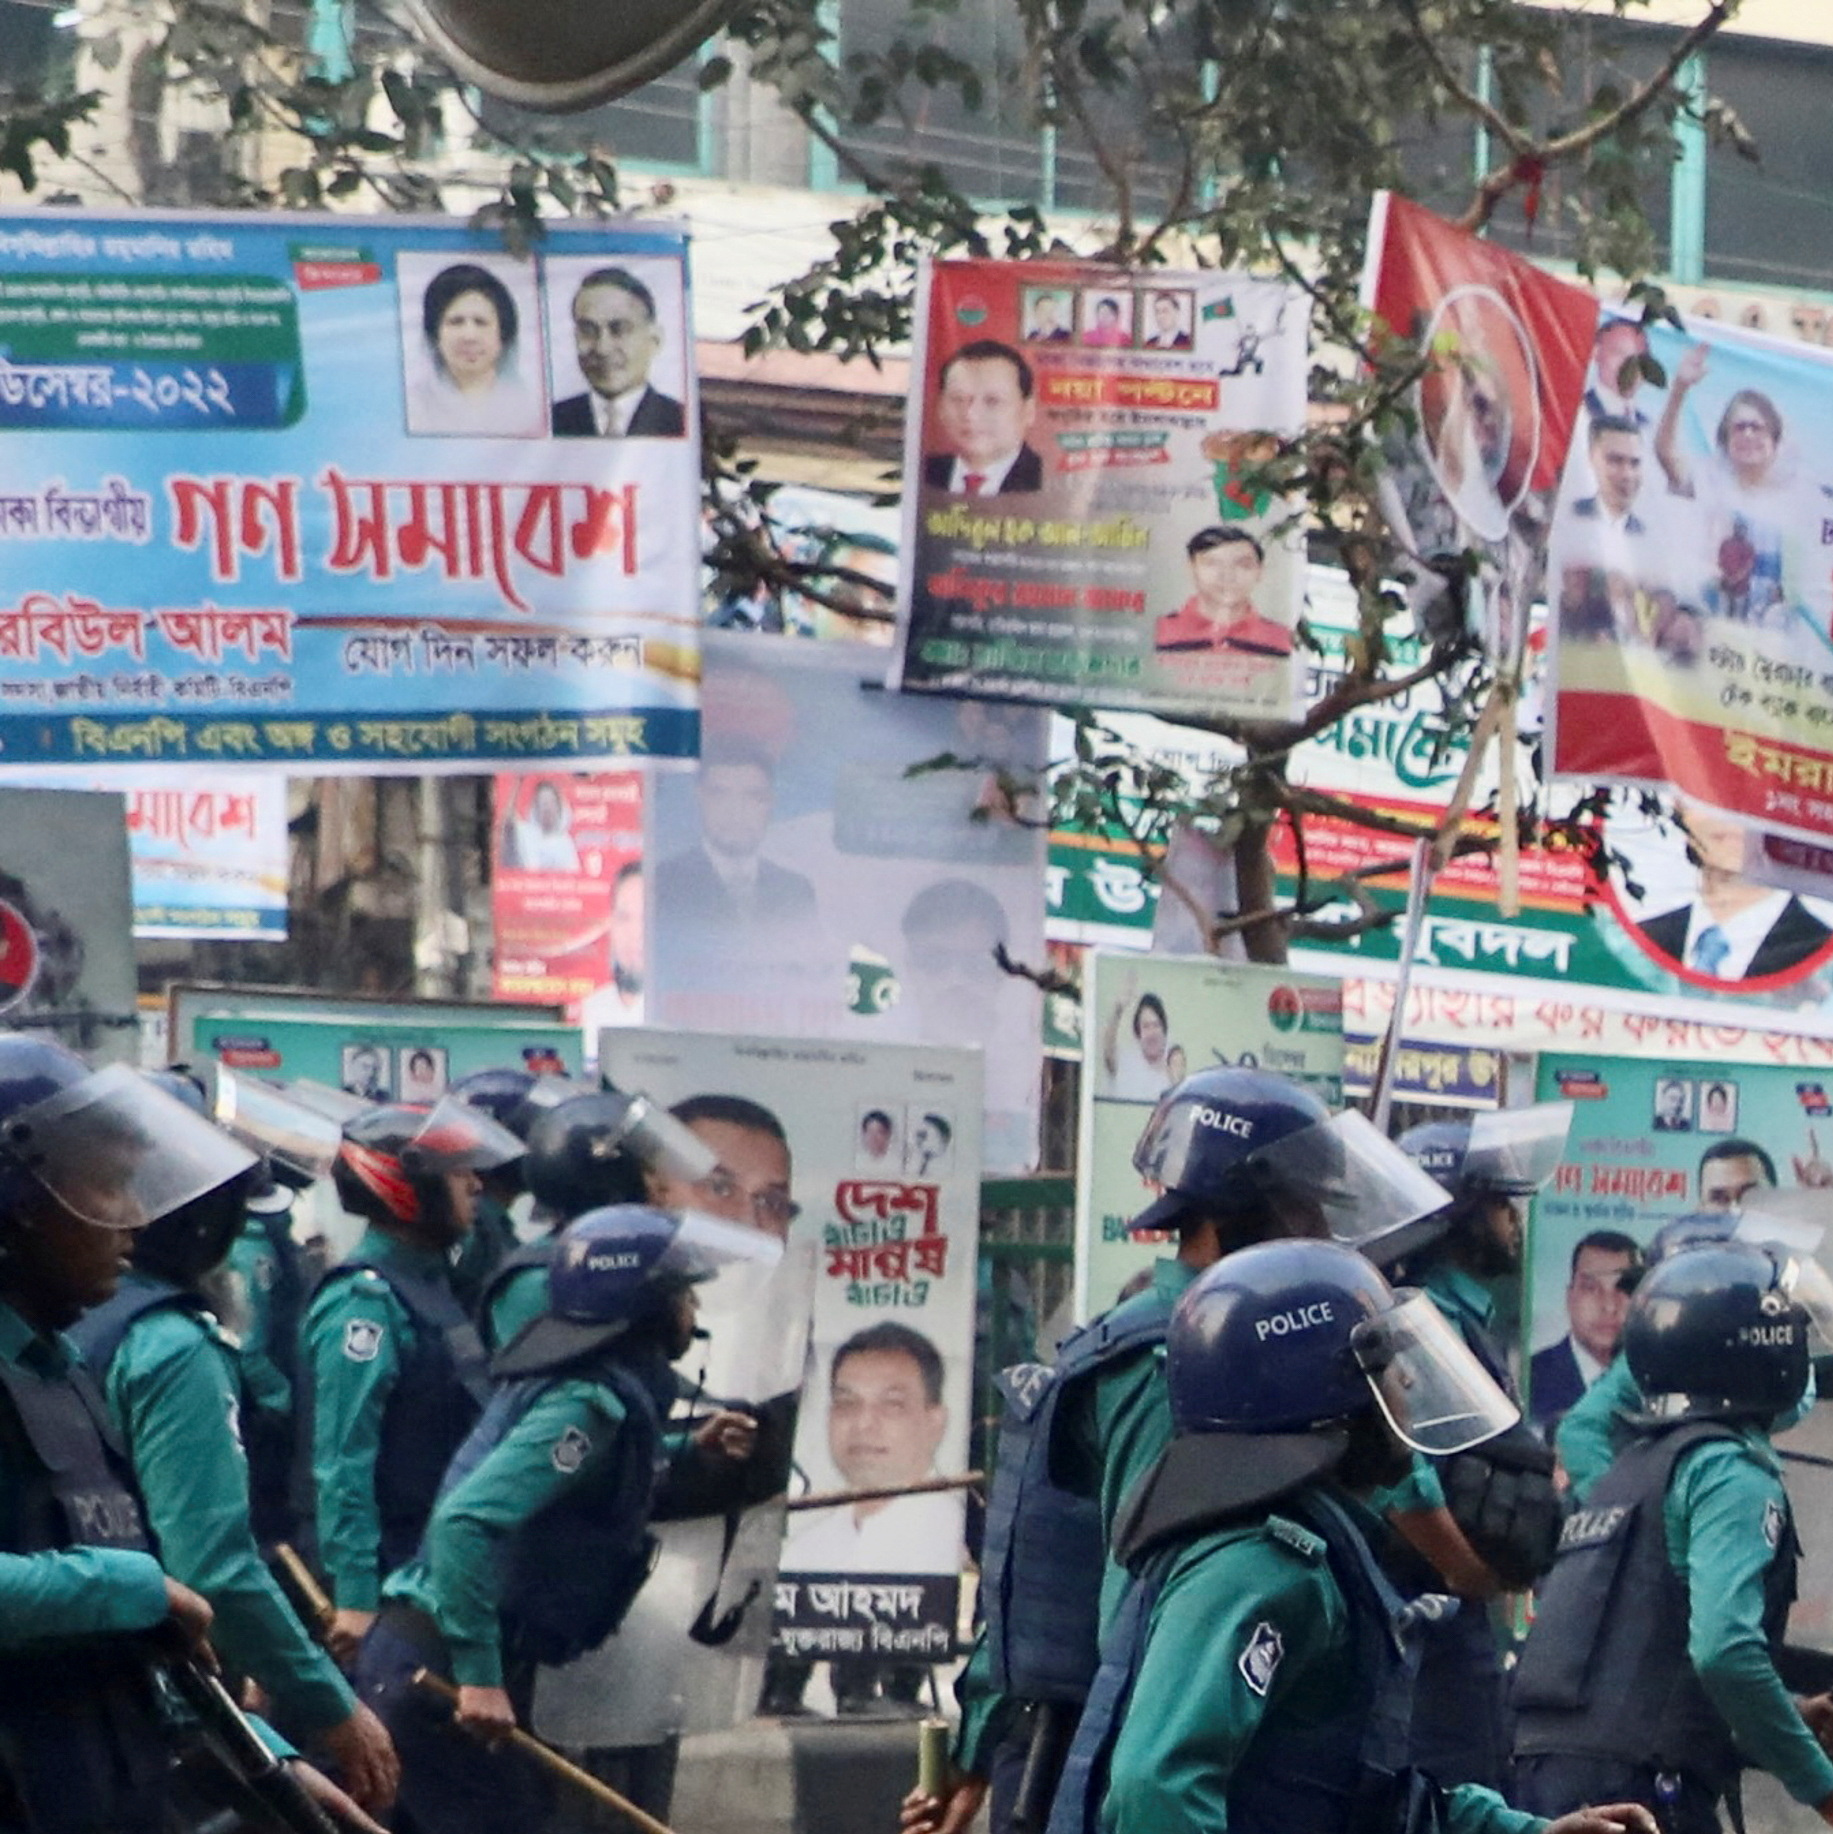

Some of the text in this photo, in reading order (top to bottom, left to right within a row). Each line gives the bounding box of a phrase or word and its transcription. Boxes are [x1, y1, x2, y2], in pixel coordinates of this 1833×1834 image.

[44, 481, 148, 538] বিভাগীয়
[168, 477, 300, 580] গণ
[320, 467, 641, 614] সমাবেশ
[0, 597, 295, 661] রবিউল আলম
[345, 632, 413, 673] যোগ
[421, 627, 477, 673] দিন
[126, 791, 257, 850] মাবেশ
[1189, 1104, 1254, 1139] POLICE
[1409, 1151, 1455, 1169] OLICE
[835, 1177, 942, 1236] দেশ
[588, 1250, 642, 1271] POLICE
[1254, 1301, 1335, 1343] POLICE
[807, 1579, 926, 1624] আহমদ
